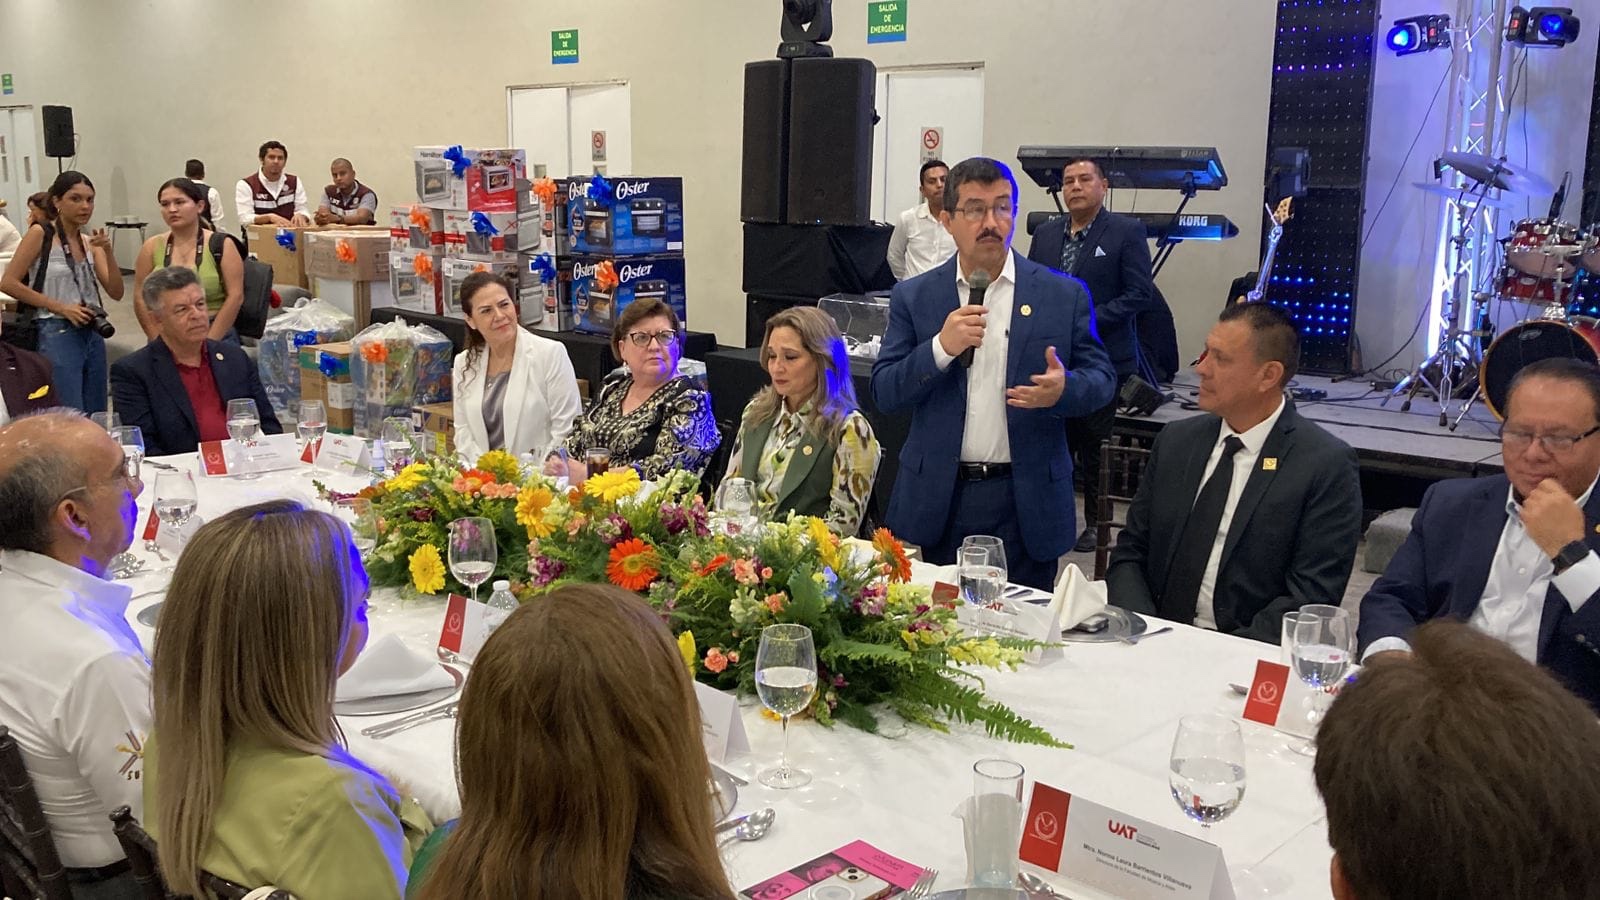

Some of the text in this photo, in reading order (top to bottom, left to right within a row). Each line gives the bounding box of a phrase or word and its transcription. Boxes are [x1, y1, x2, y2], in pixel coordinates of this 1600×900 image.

[879, 3, 898, 12] SALIDA
[883, 14, 892, 22] DE
[870, 24, 905, 34] EMERGENCIA
[562, 40, 568, 48] DE
[553, 49, 577, 57] EMERGENCIA
[616, 181, 650, 200] Oster
[1179, 215, 1208, 227] KORG
[573, 262, 596, 281] Oster
[620, 264, 653, 283] Oster
[1108, 819, 1138, 840] UAT
[1097, 848, 1115, 860] Norma
[1116, 855, 1132, 867] Laura
[1133, 862, 1162, 879] Barrientos
[1163, 873, 1192, 890] Villanueva
